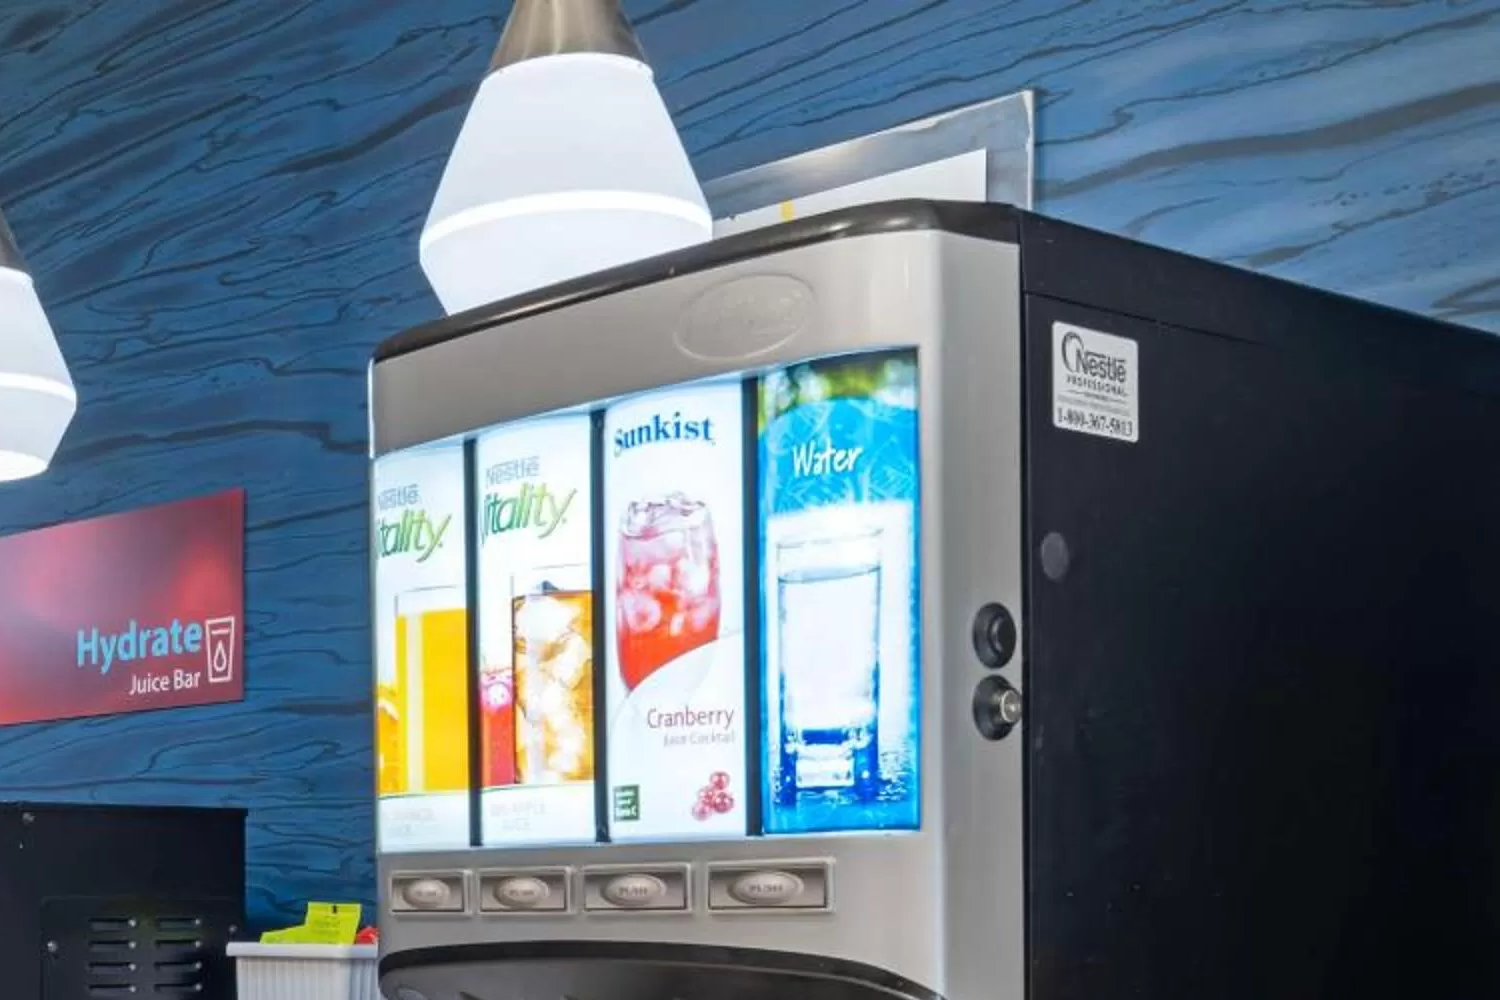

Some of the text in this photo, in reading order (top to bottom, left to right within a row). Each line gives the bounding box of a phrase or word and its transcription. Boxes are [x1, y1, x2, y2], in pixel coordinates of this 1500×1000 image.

[614, 411, 713, 458] Sunkist
[792, 437, 863, 478] Water
[77, 617, 203, 675] Hydrate
[129, 669, 201, 696] Juice Bar
[648, 705, 734, 730] Cranberry
